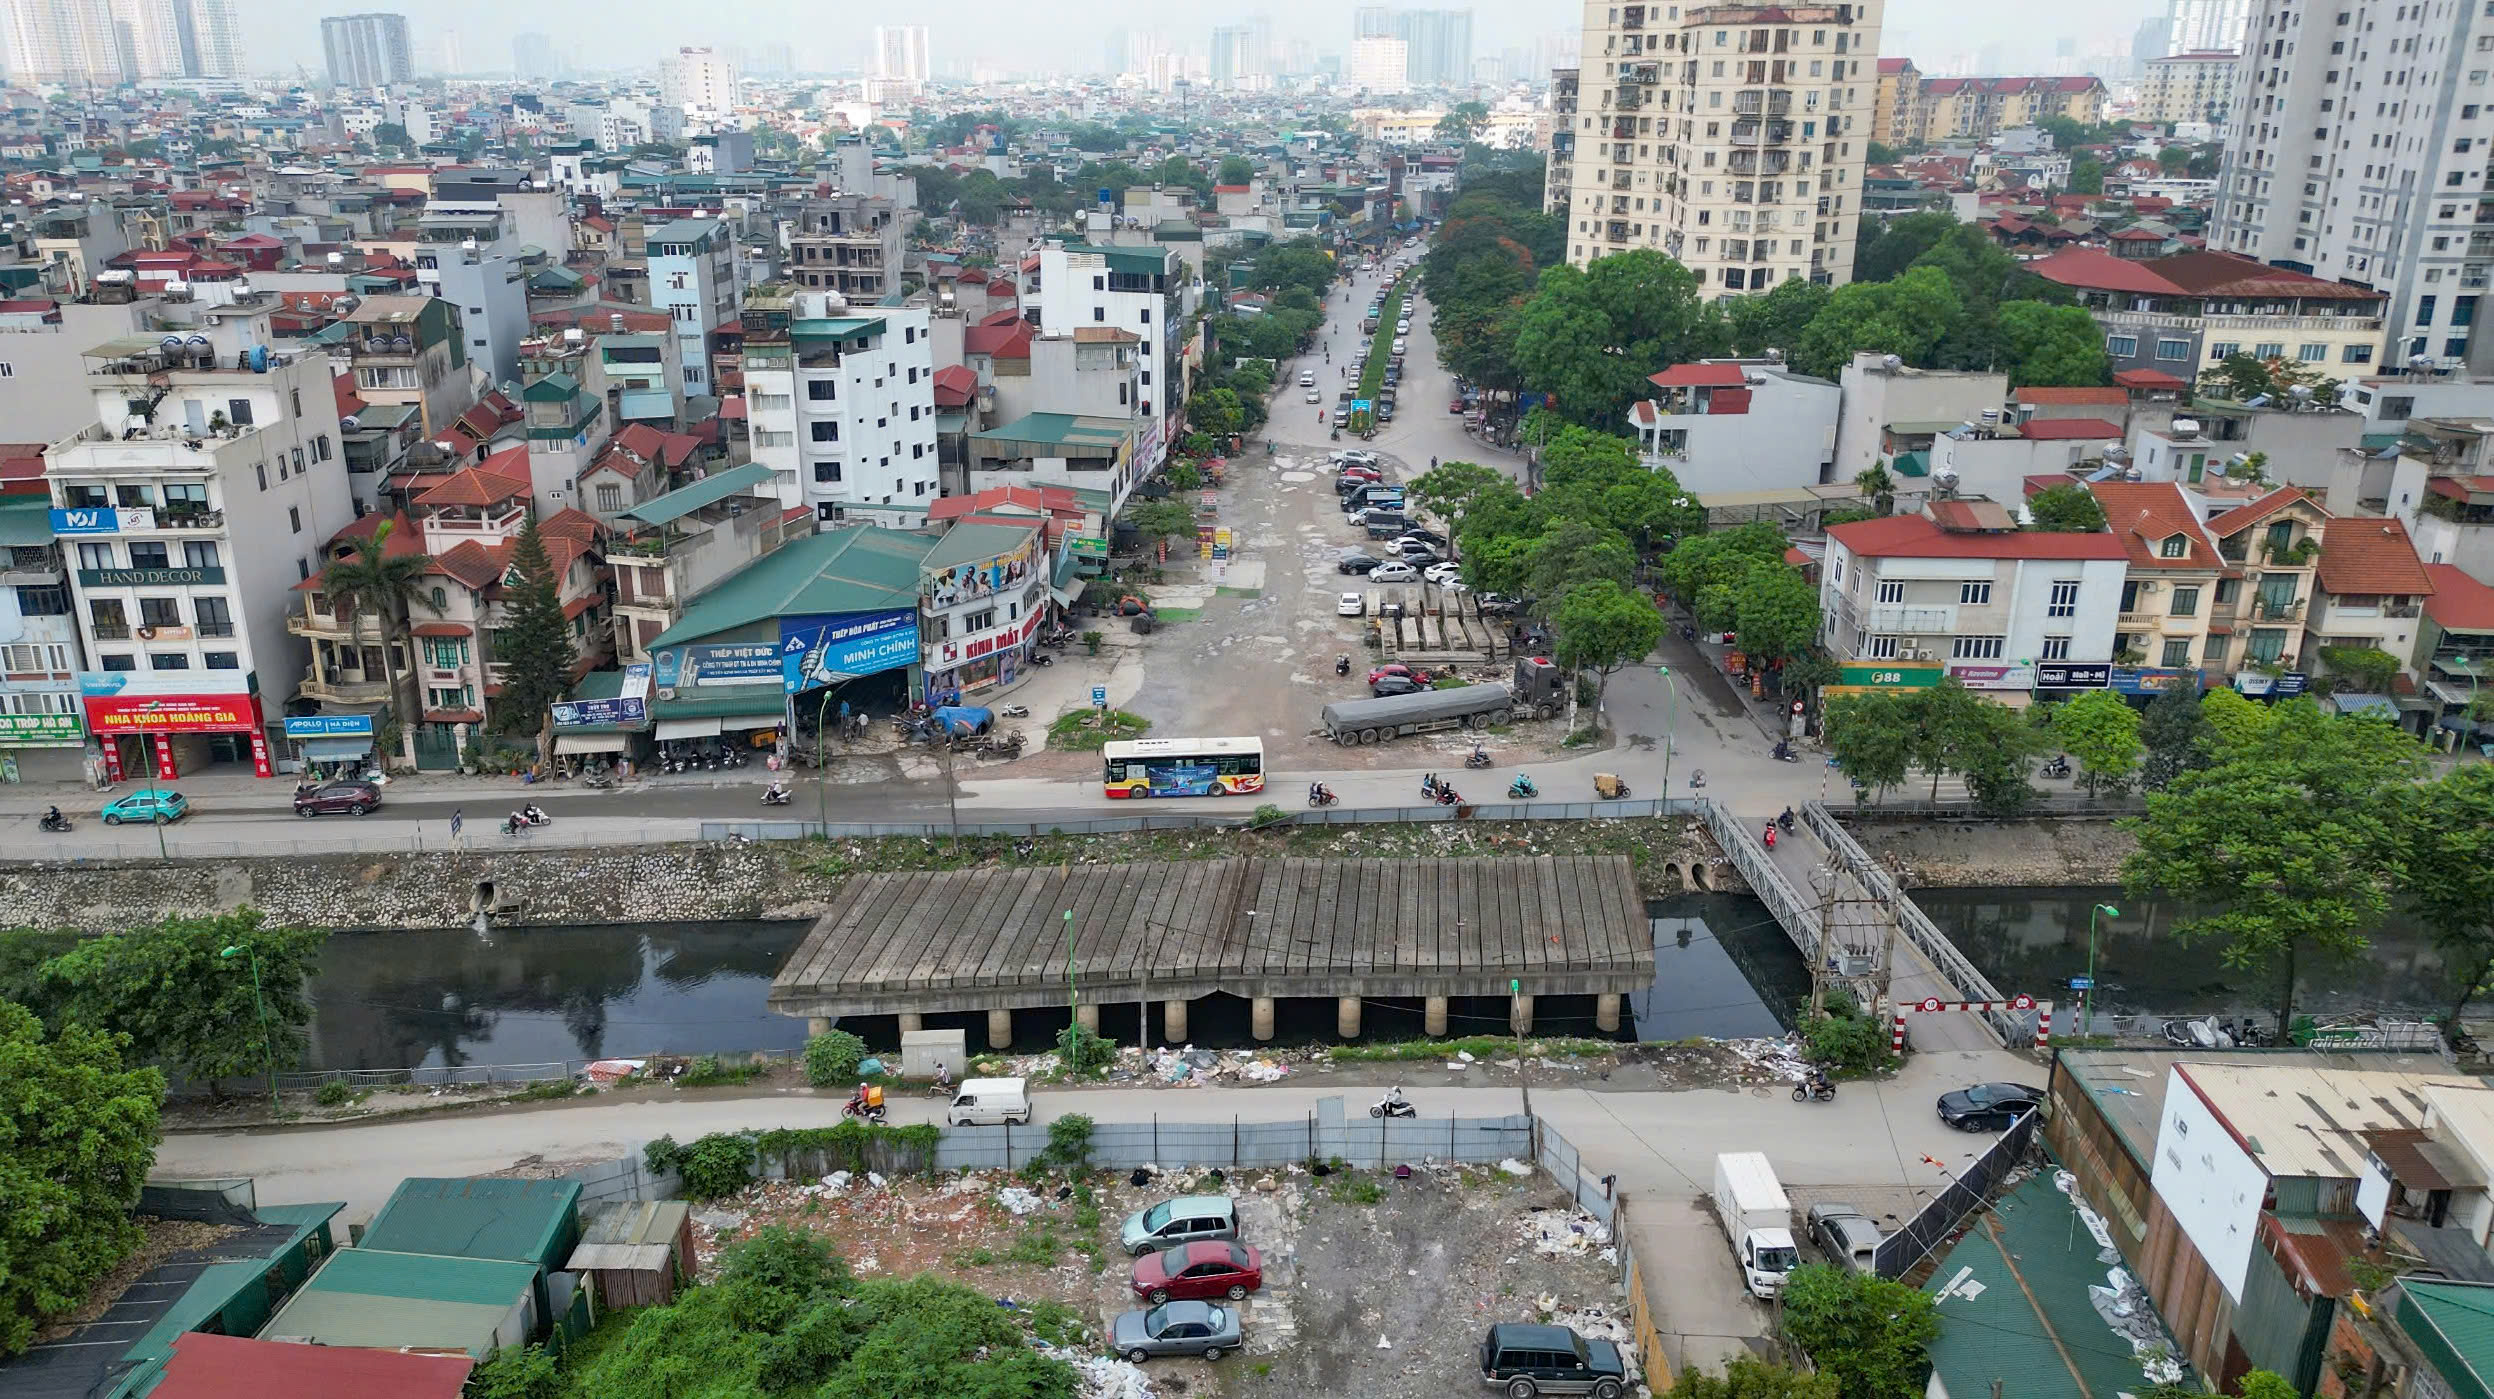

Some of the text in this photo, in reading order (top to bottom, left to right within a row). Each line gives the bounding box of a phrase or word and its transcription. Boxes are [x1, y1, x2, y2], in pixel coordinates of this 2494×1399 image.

[100, 570, 203, 585] HAND DECOR
[832, 628, 849, 640] THÉP
[863, 621, 880, 633] PHÁT
[966, 637, 993, 659] KÍNH
[996, 626, 1019, 649] MẮT
[710, 648, 732, 658] THÉP
[734, 647, 753, 658] VIỆT
[843, 647, 876, 665] MINH
[878, 638, 916, 656] CHÍNH
[104, 712, 131, 725] NHA
[133, 712, 166, 725] KHOA
[215, 712, 237, 722] GIA
[289, 720, 322, 729] APOLLO
